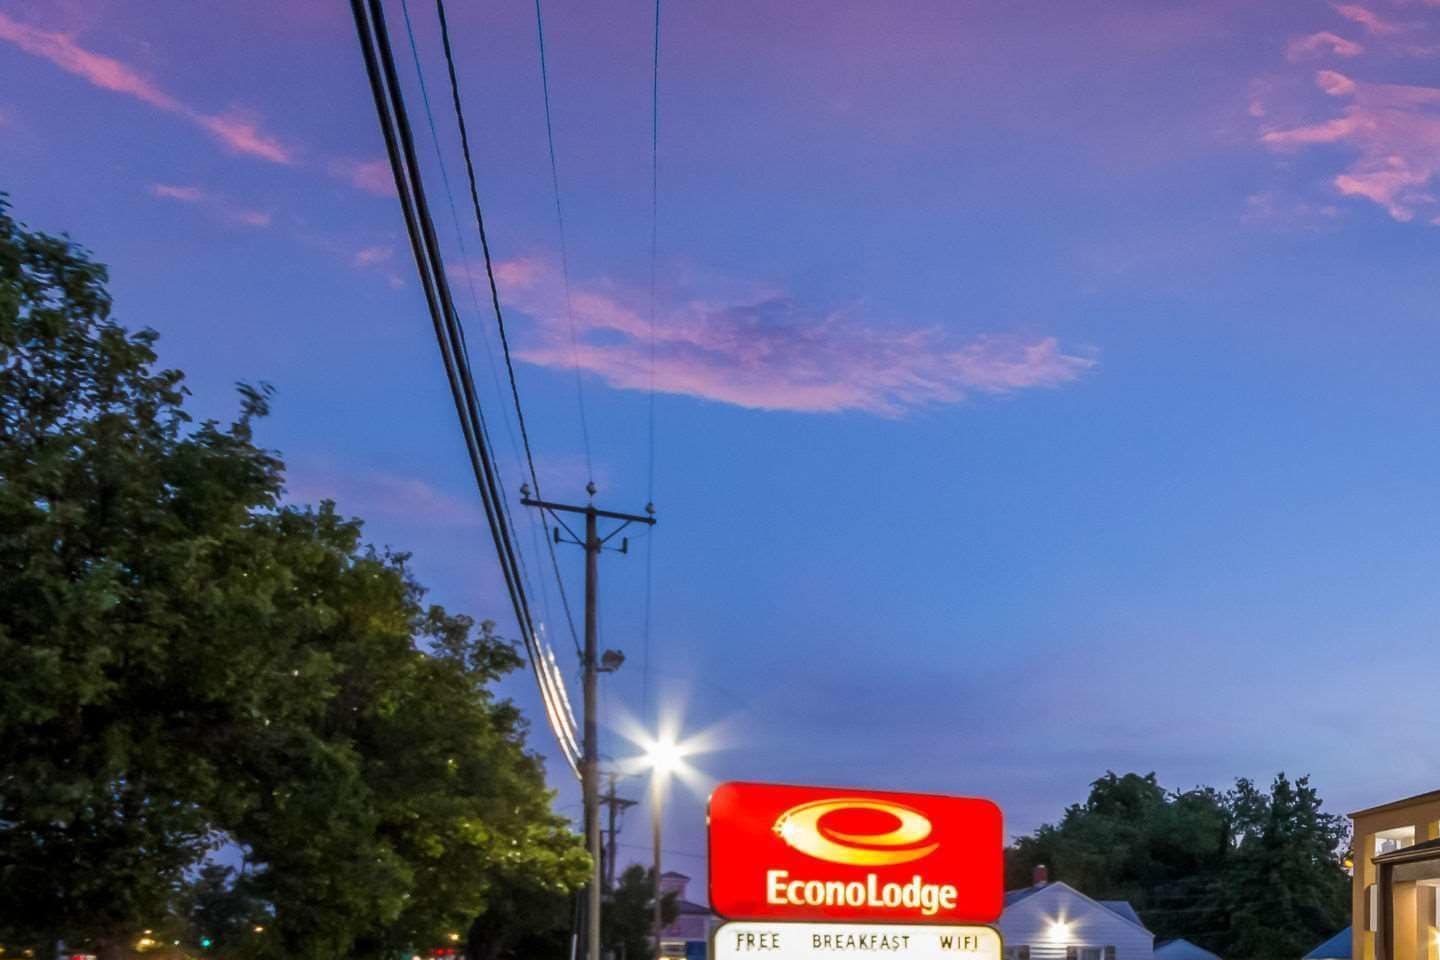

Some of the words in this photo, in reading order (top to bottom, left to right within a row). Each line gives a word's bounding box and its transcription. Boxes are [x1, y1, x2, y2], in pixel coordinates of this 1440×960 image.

[767, 870, 958, 915] EconoLodge
[736, 932, 781, 951] FREE
[812, 933, 910, 951] BREAKFAST
[939, 935, 979, 951] WIFI
